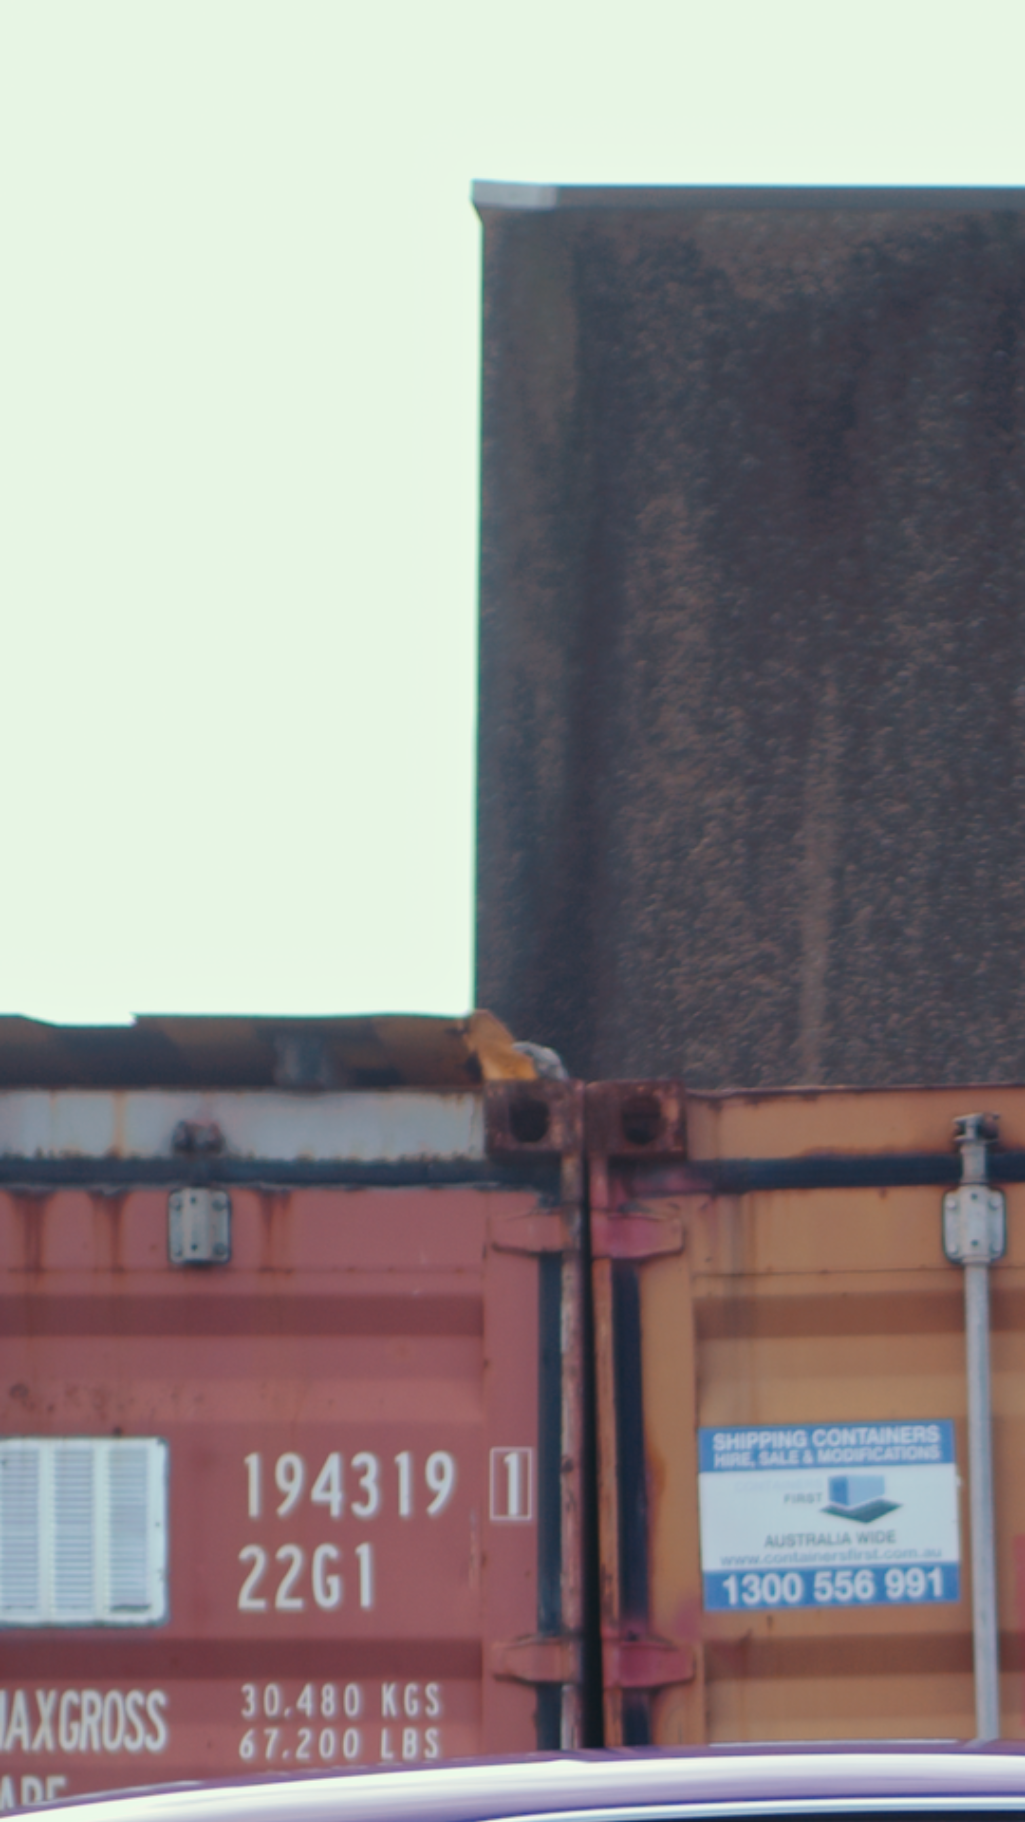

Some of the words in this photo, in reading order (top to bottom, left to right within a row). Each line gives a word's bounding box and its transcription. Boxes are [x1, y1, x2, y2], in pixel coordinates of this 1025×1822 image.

[713, 1429, 807, 1451] SHIPPING
[812, 1425, 940, 1447] CONTAINERS
[713, 1451, 756, 1469] HIRE,
[759, 1449, 799, 1466] SALE
[801, 1449, 813, 1464] &
[817, 1445, 941, 1464] MODIFICATIONS
[243, 1451, 456, 1518] 194319
[503, 1452, 521, 1517] 1
[784, 1492, 823, 1504] FIRST
[764, 1532, 851, 1548] AUSTRALIA
[855, 1530, 896, 1545] WIDE
[720, 1548, 942, 1567] www.containersfirst.com.au
[237, 1543, 375, 1611] 22G1
[722, 1573, 804, 1606] 1300
[813, 1569, 876, 1602] 556
[885, 1567, 944, 1600] 991
[380, 1683, 441, 1718] KGS
[379, 1728, 441, 1761] LBS
